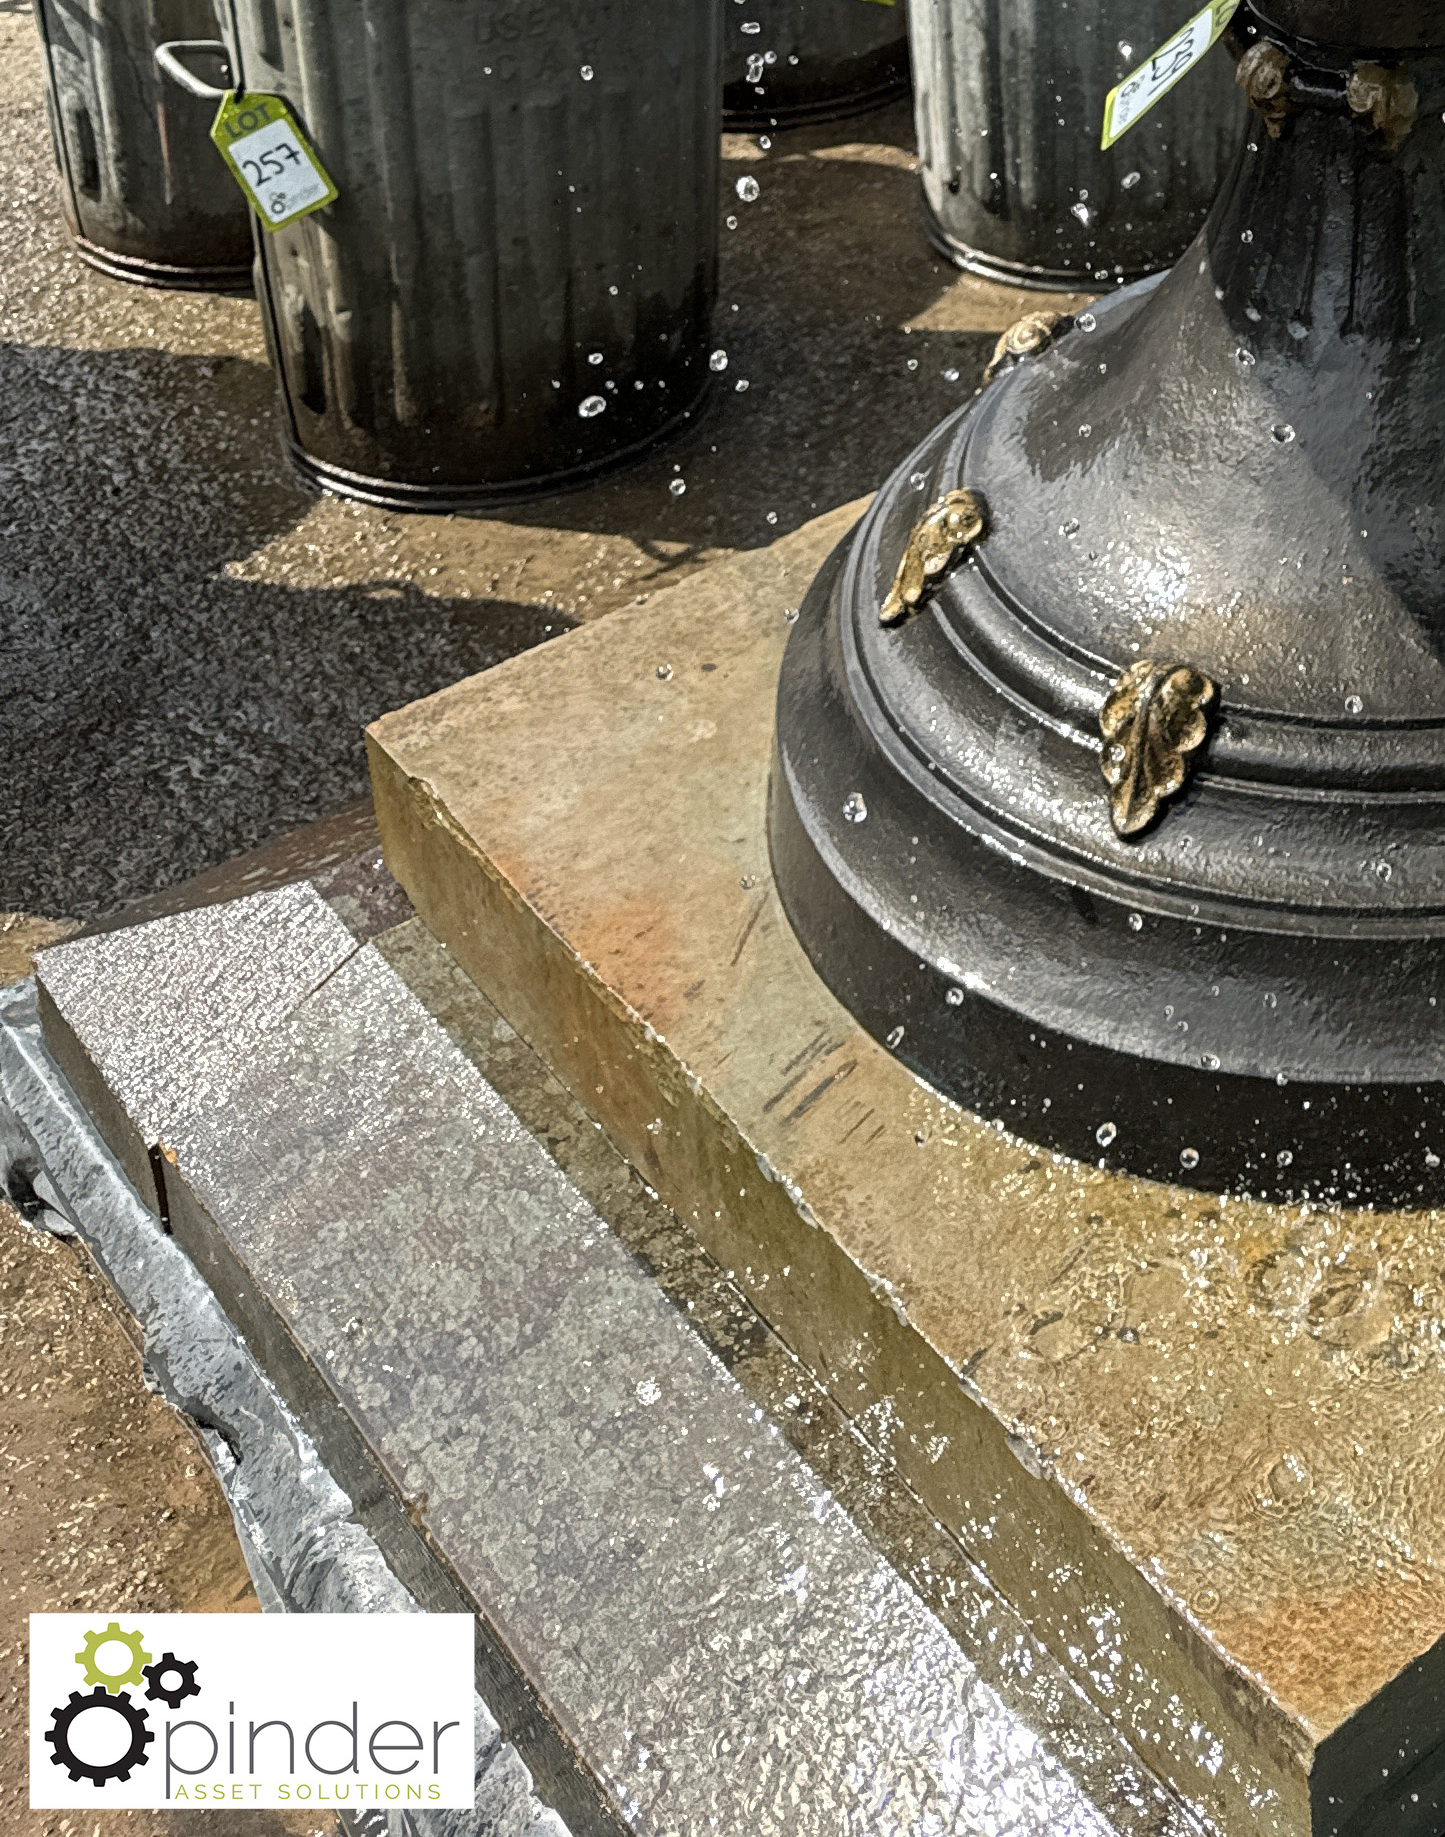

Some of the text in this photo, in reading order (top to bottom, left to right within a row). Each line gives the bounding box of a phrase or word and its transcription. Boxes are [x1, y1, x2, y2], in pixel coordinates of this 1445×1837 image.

[1147, 27, 1194, 97] 239
[224, 103, 271, 139] LOT
[242, 143, 300, 187] 257
